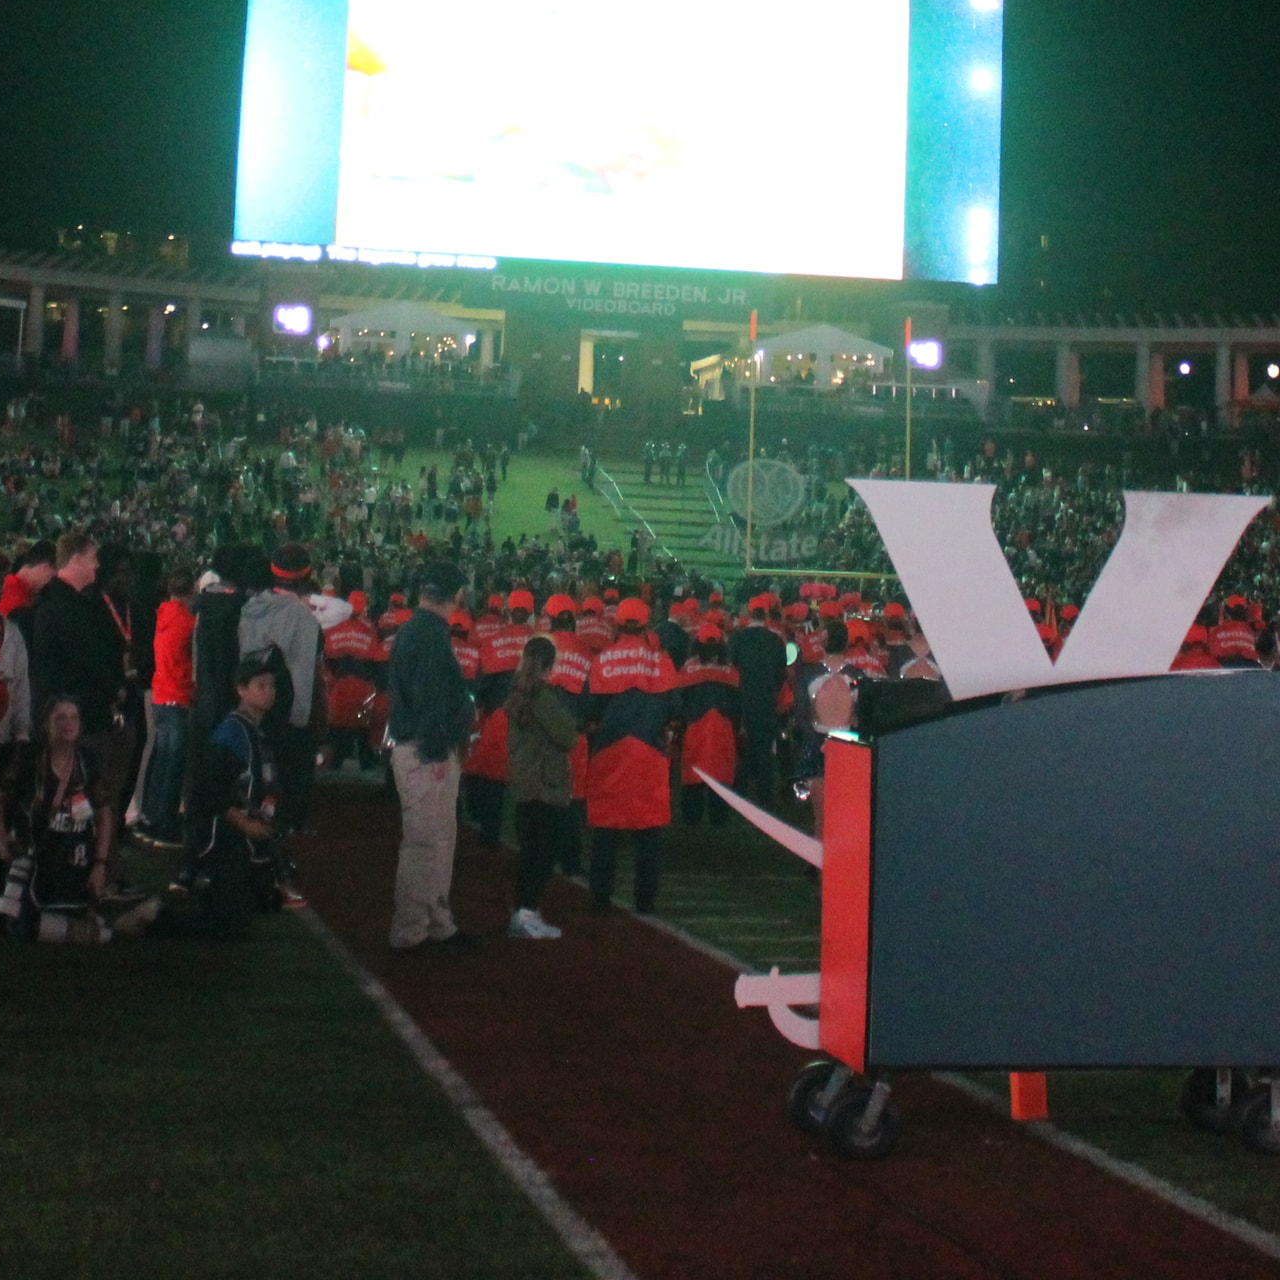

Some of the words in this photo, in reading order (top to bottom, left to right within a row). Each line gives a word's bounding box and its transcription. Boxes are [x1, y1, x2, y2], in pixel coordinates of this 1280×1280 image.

[492, 274, 576, 296] RAMON
[566, 297, 676, 316] VIDEOBOARD
[697, 523, 819, 562] Allstate
